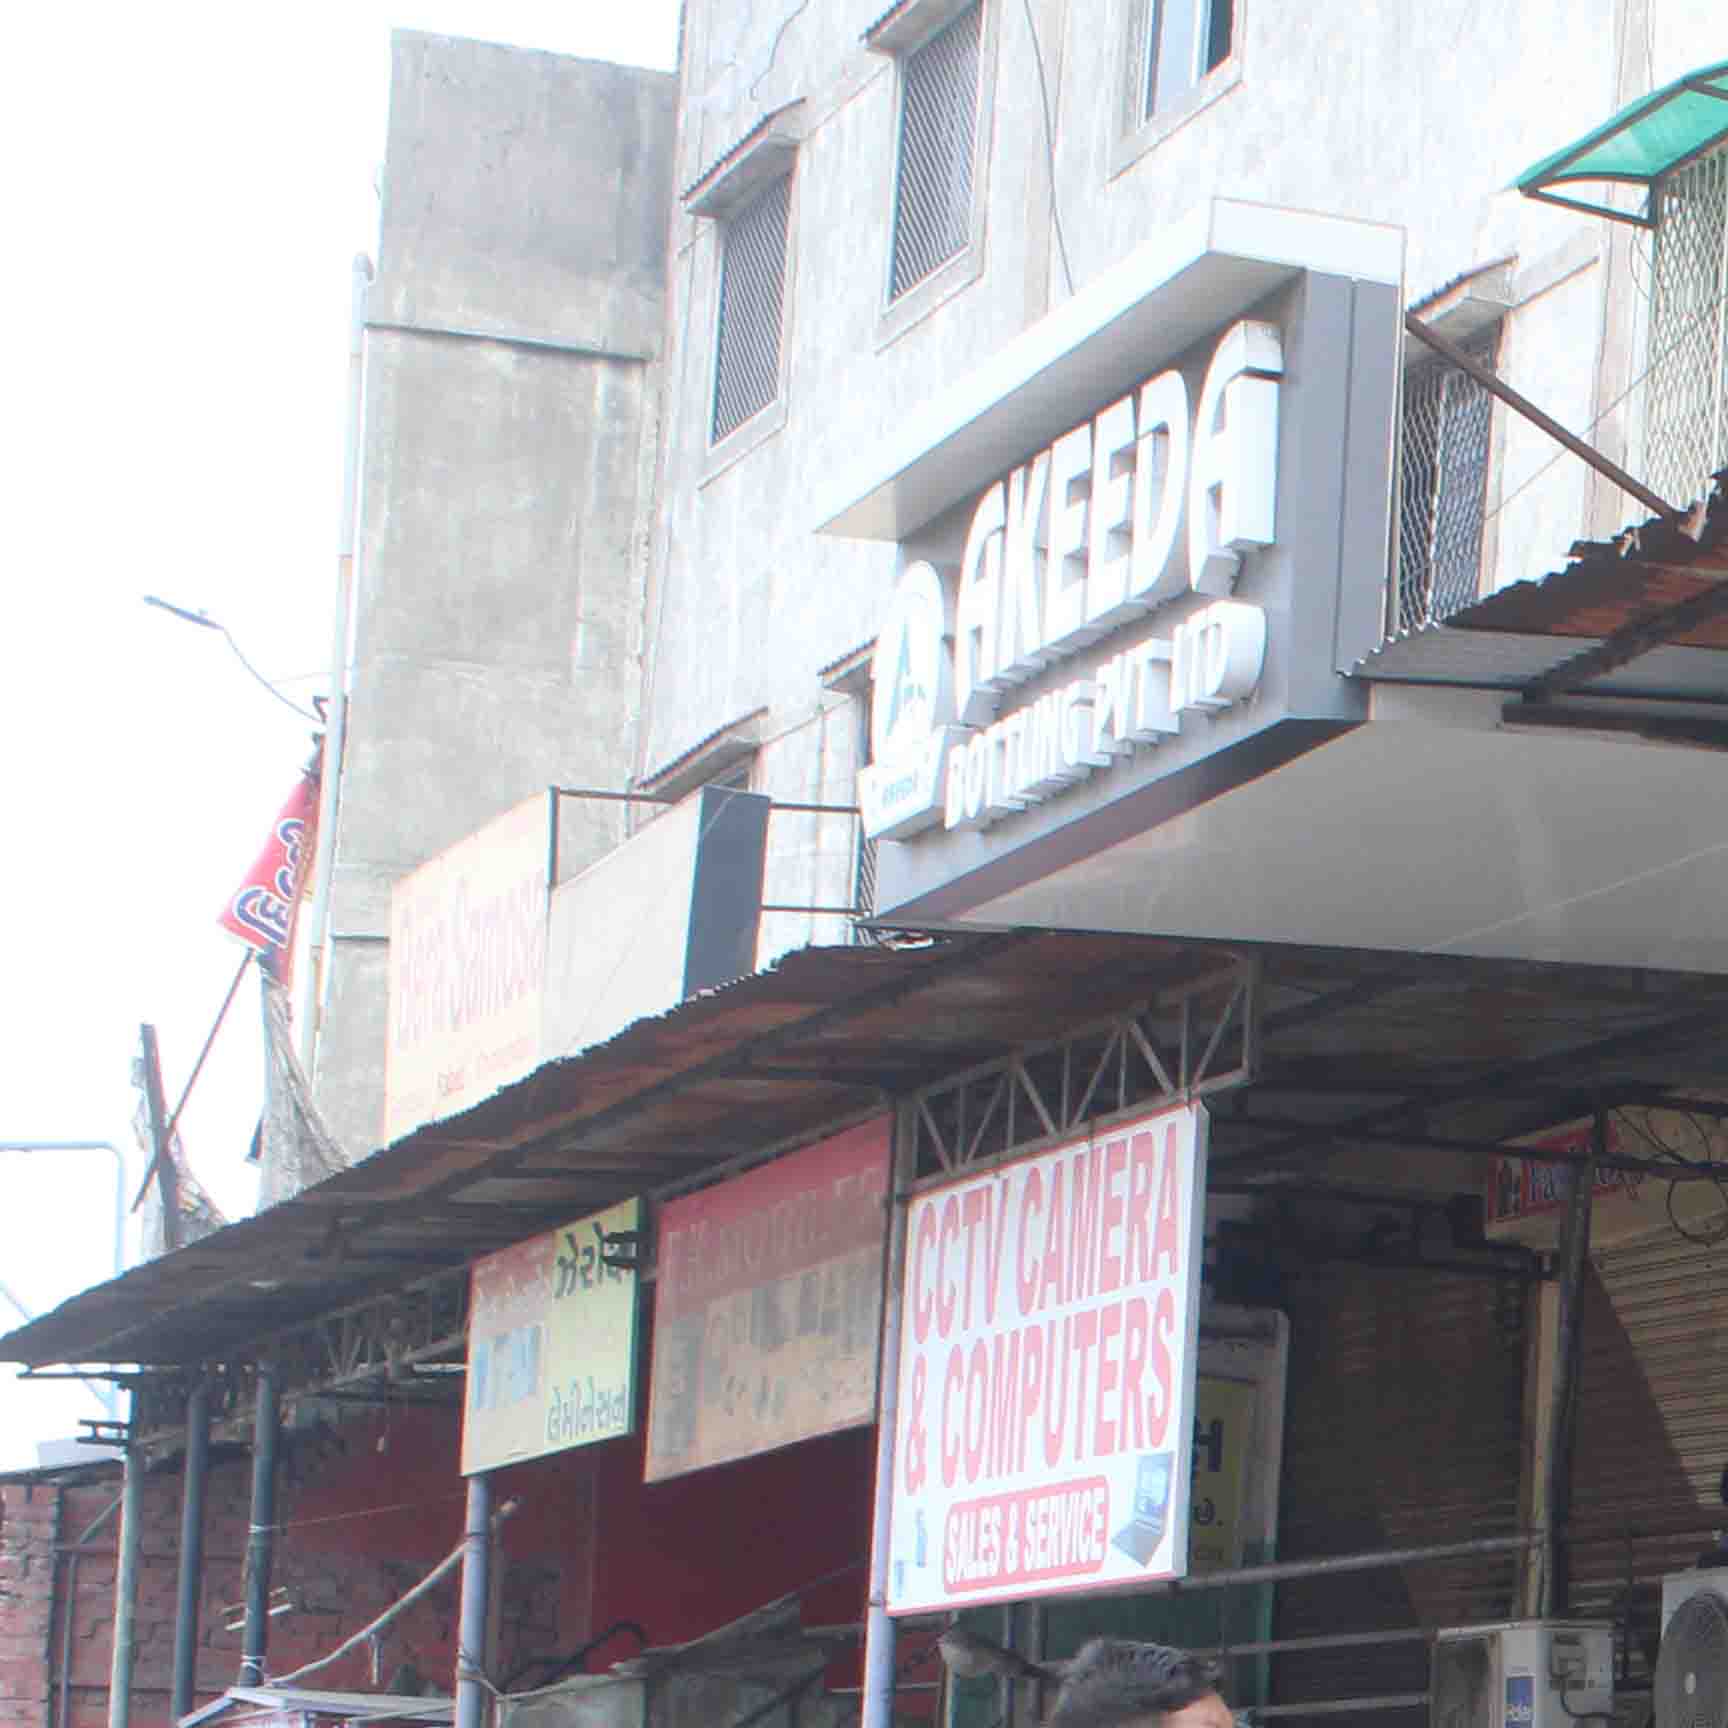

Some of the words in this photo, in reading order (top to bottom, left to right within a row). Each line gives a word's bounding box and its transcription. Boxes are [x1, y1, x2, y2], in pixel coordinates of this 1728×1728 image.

[954, 319, 1284, 728] AKEEDA
[911, 1177, 1012, 1345] CCTV
[1014, 1121, 1178, 1317] CAMERA
[905, 1352, 928, 1496] &
[940, 1287, 1176, 1488] COMPUTERS
[947, 1500, 1003, 1584] SALES
[1023, 1486, 1107, 1571] SERVICE
